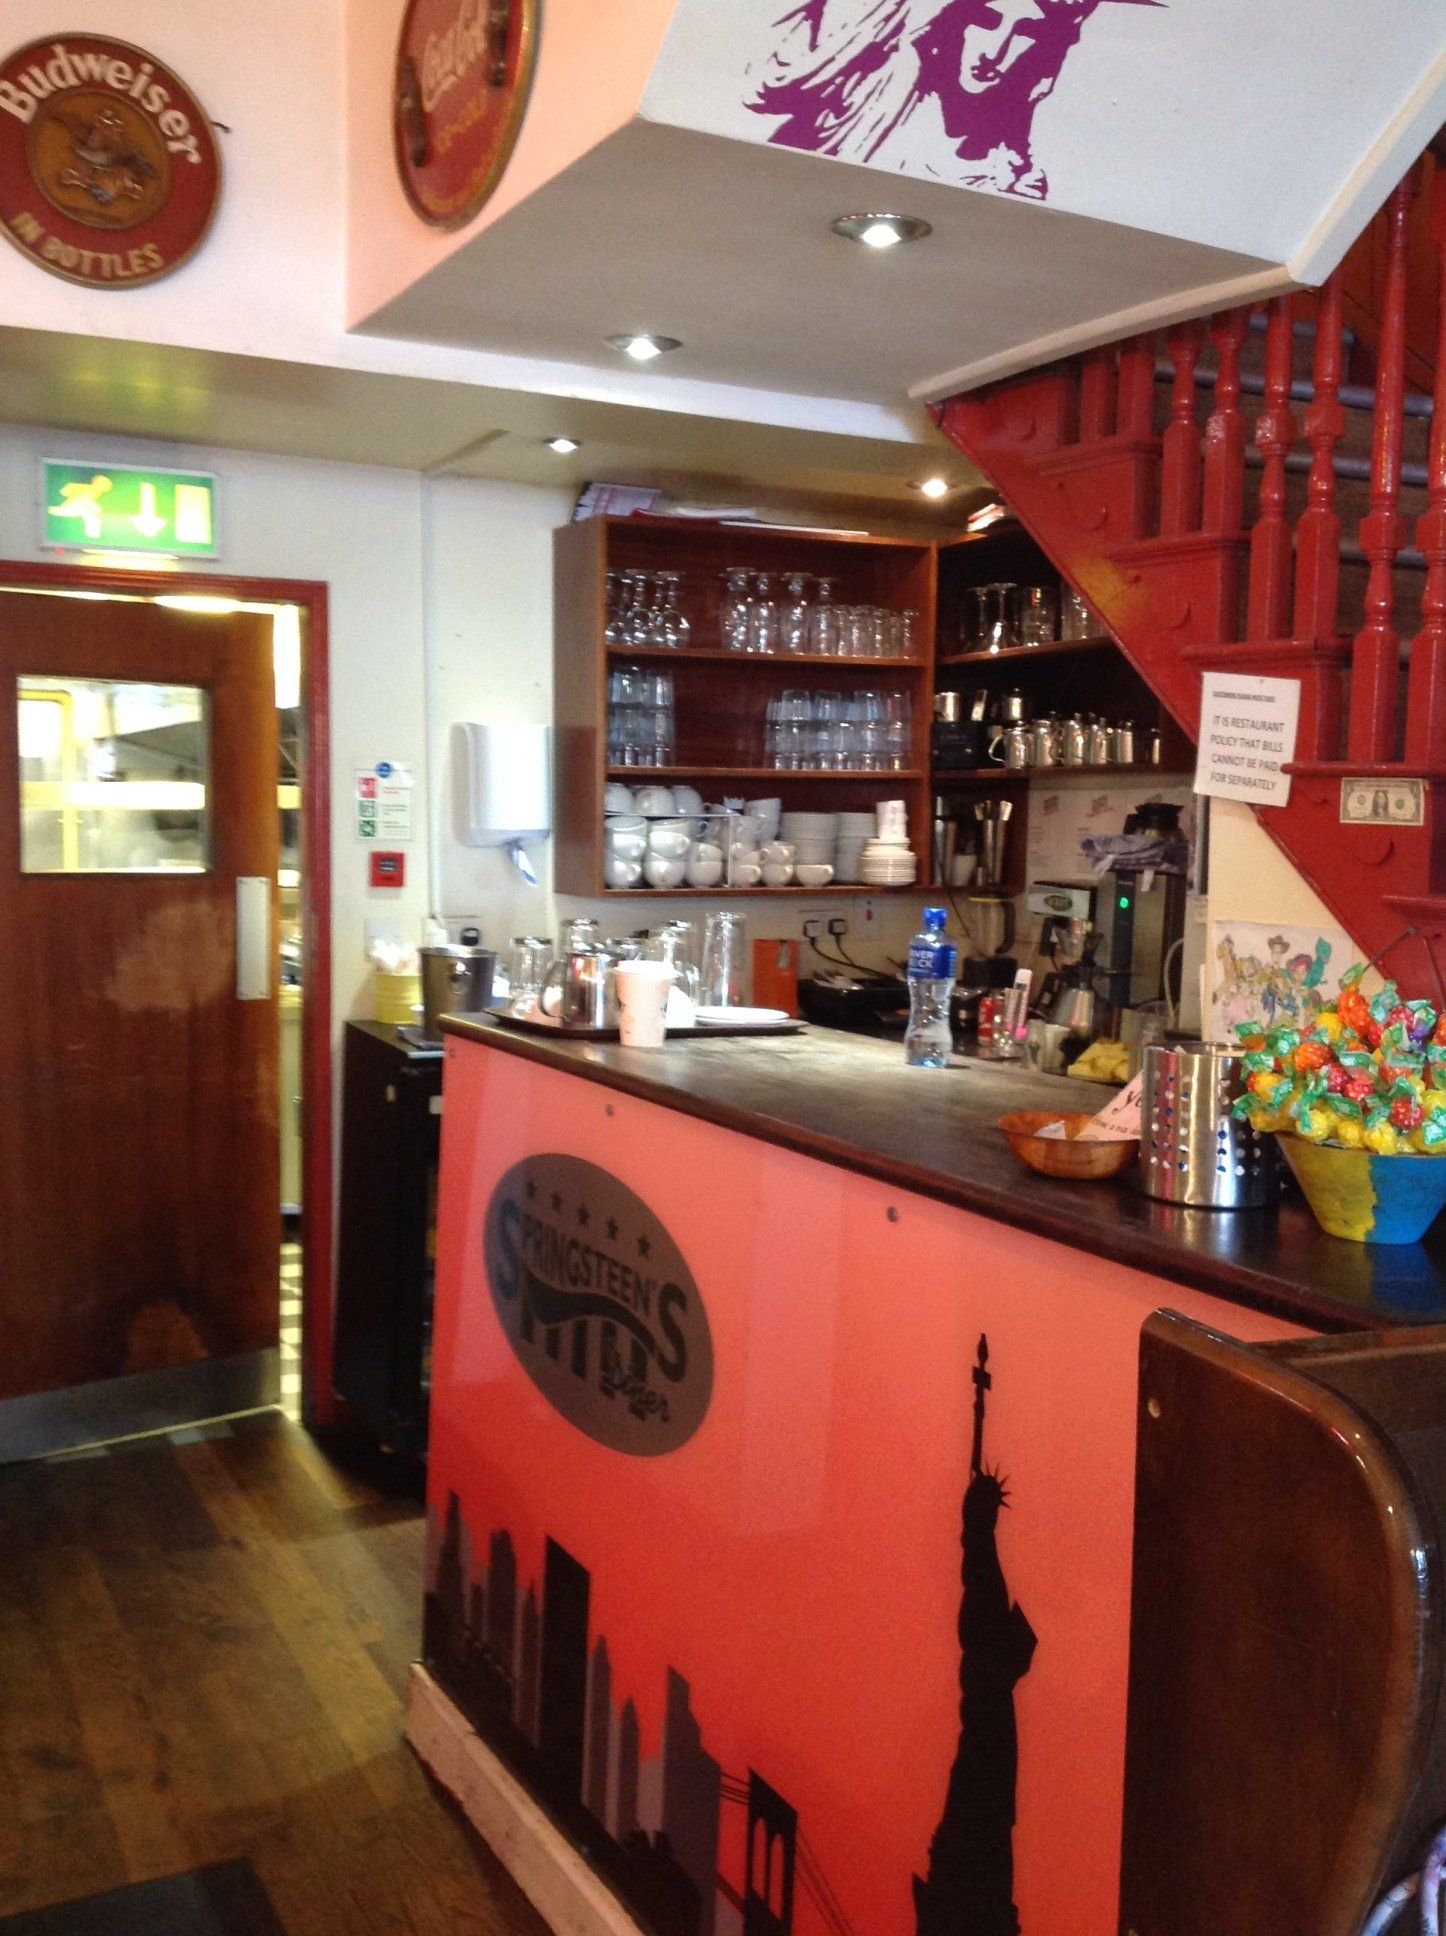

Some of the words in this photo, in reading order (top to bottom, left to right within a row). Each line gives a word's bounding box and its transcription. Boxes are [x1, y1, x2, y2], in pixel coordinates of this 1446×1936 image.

[0, 44, 202, 164] Budweiser
[41, 237, 164, 277] BOTTLES
[1213, 716, 1220, 726] IT
[1221, 717, 1230, 728] IS
[1230, 717, 1285, 733] RESTAURANT
[1210, 734, 1238, 747] POLICY
[1239, 737, 1261, 749] THAT
[1261, 740, 1284, 753] BILLS
[1211, 753, 1245, 767] CANNOT
[1246, 758, 1257, 769] BE
[1258, 759, 1278, 771] PAID
[1210, 771, 1226, 782] FOR
[1227, 774, 1276, 790] SEPARATELY
